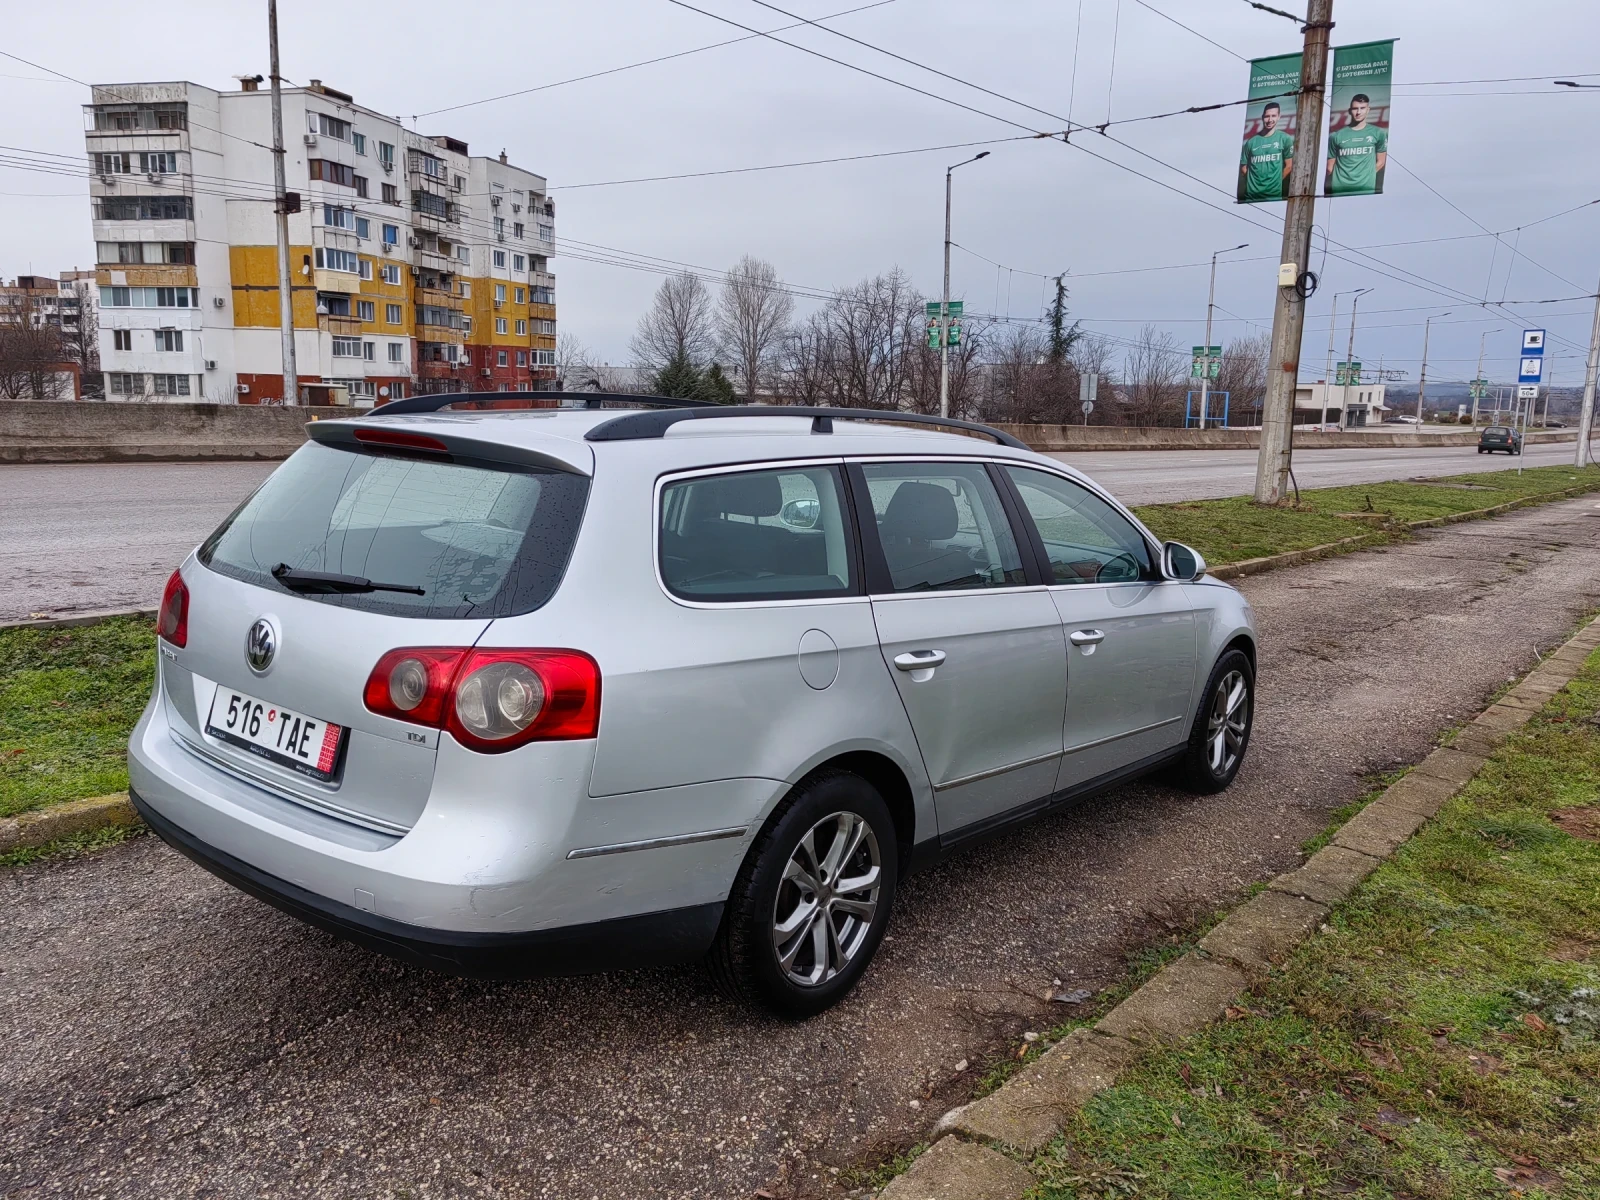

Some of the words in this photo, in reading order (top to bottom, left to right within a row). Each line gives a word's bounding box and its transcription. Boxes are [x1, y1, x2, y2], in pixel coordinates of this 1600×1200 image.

[1339, 146, 1373, 156] WINBET
[1250, 152, 1282, 163] WINBET
[226, 694, 264, 738] 516
[276, 712, 316, 759] TAE
[405, 731, 426, 744] TDI
